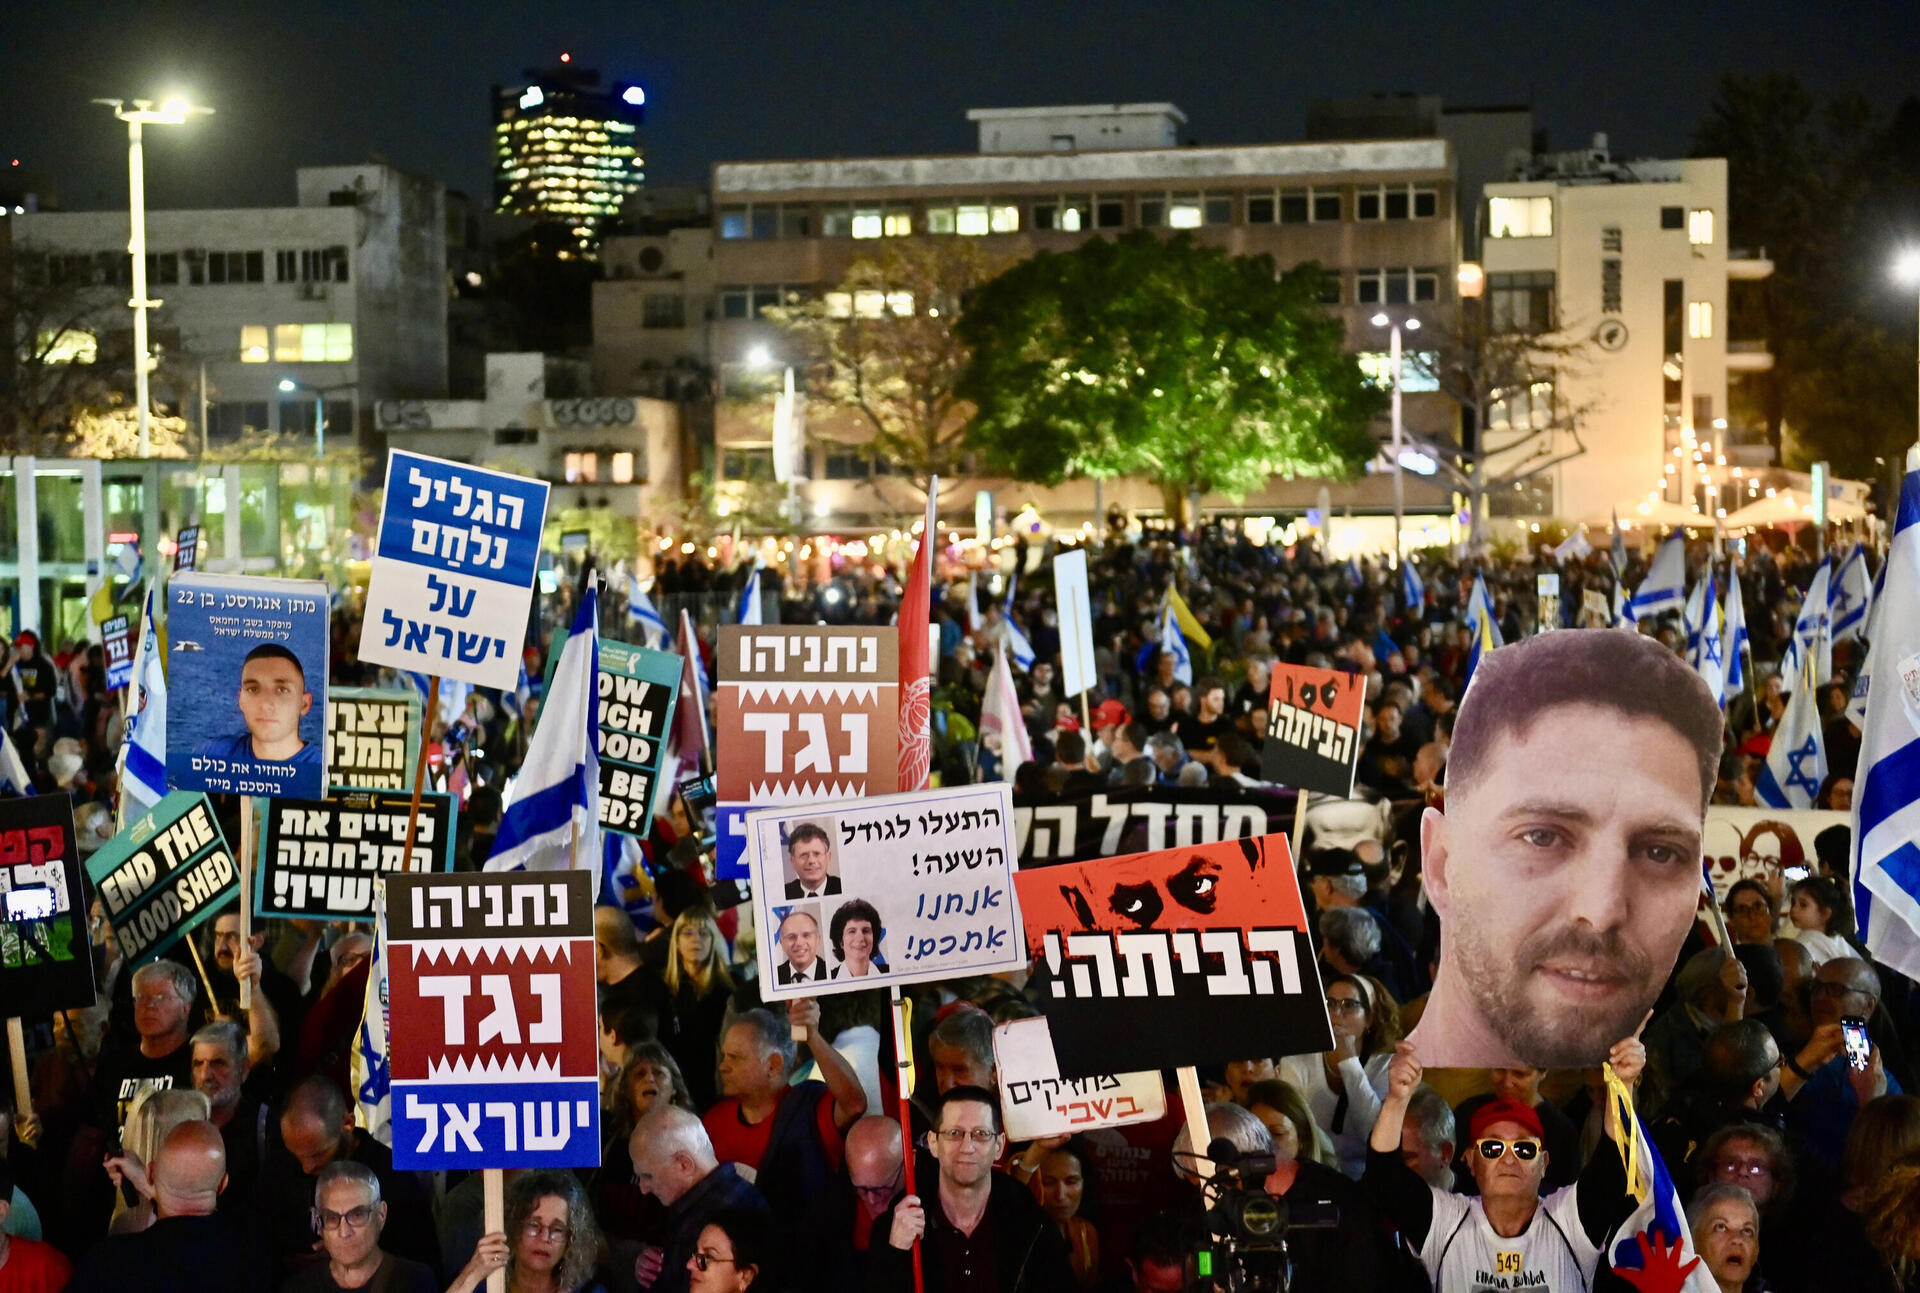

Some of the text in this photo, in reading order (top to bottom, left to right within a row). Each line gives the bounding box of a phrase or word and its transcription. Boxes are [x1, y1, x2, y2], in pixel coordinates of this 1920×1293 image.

[409, 467, 524, 530] הגליל
[177, 590, 317, 613] מתן אנגרסט, בן 22
[427, 574, 477, 618] על
[209, 616, 292, 630] מופקר בשבי החמאס
[214, 626, 241, 638] ישראל
[243, 629, 274, 640] ממשלת
[382, 608, 506, 664] ישראל
[739, 635, 878, 673] נתניהו
[598, 671, 651, 706] OW
[328, 731, 404, 769] המל
[743, 713, 869, 775] נגד
[1268, 698, 1354, 765] הביתה!
[191, 755, 297, 778] להחזיר את כולם
[205, 778, 231, 790] מייד
[610, 769, 648, 801] BE
[280, 809, 435, 843] לסיים את
[840, 808, 1000, 846] התעלו לגודל
[1091, 794, 1268, 857] מחדל
[101, 851, 157, 915] END
[154, 804, 215, 871] THE
[277, 840, 433, 873] המלחמה
[912, 846, 1004, 876] השעה!
[117, 851, 233, 959] BLOODSHED
[273, 870, 377, 912] שיו!
[411, 883, 569, 929] נתניהו
[916, 885, 1003, 920] אנחנו
[904, 925, 1007, 960] אתכם!
[1042, 930, 1303, 998] הביתה!
[418, 973, 563, 1046] נגד
[405, 1093, 590, 1153] ישראל
[1056, 1096, 1144, 1124] בשבי
[1496, 1252, 1520, 1273] 549
